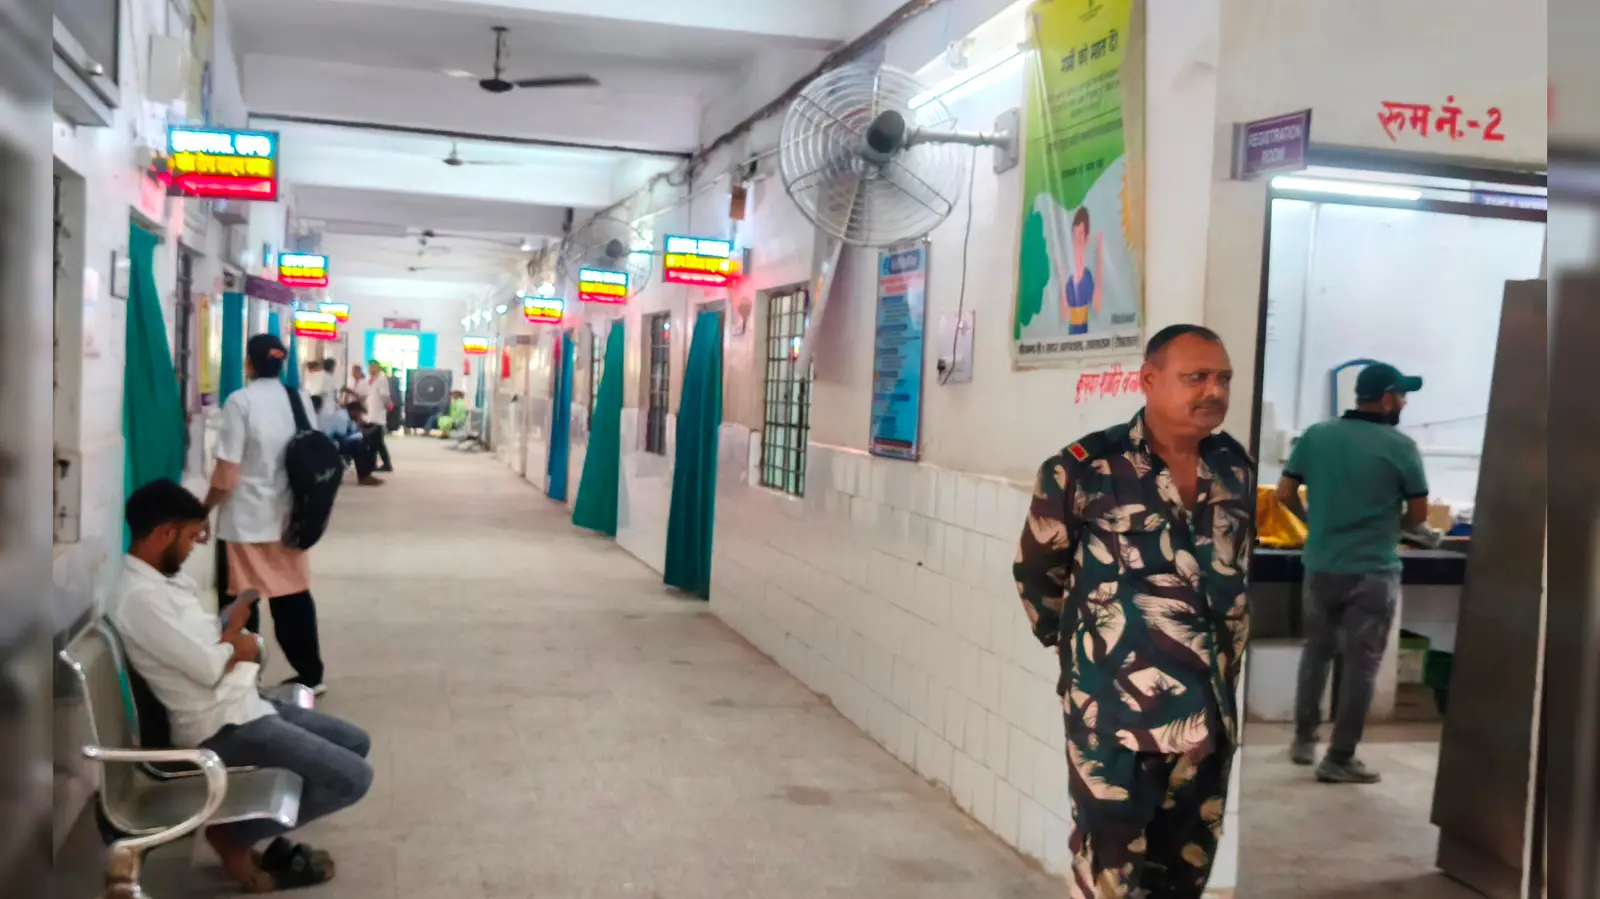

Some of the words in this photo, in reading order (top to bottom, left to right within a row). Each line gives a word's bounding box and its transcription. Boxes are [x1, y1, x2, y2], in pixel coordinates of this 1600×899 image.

[1377, 100, 1433, 143] रूम
[1247, 125, 1301, 148] REGISTRATION
[1260, 147, 1285, 164] ROOM
[1075, 373, 1100, 404] कृपया
